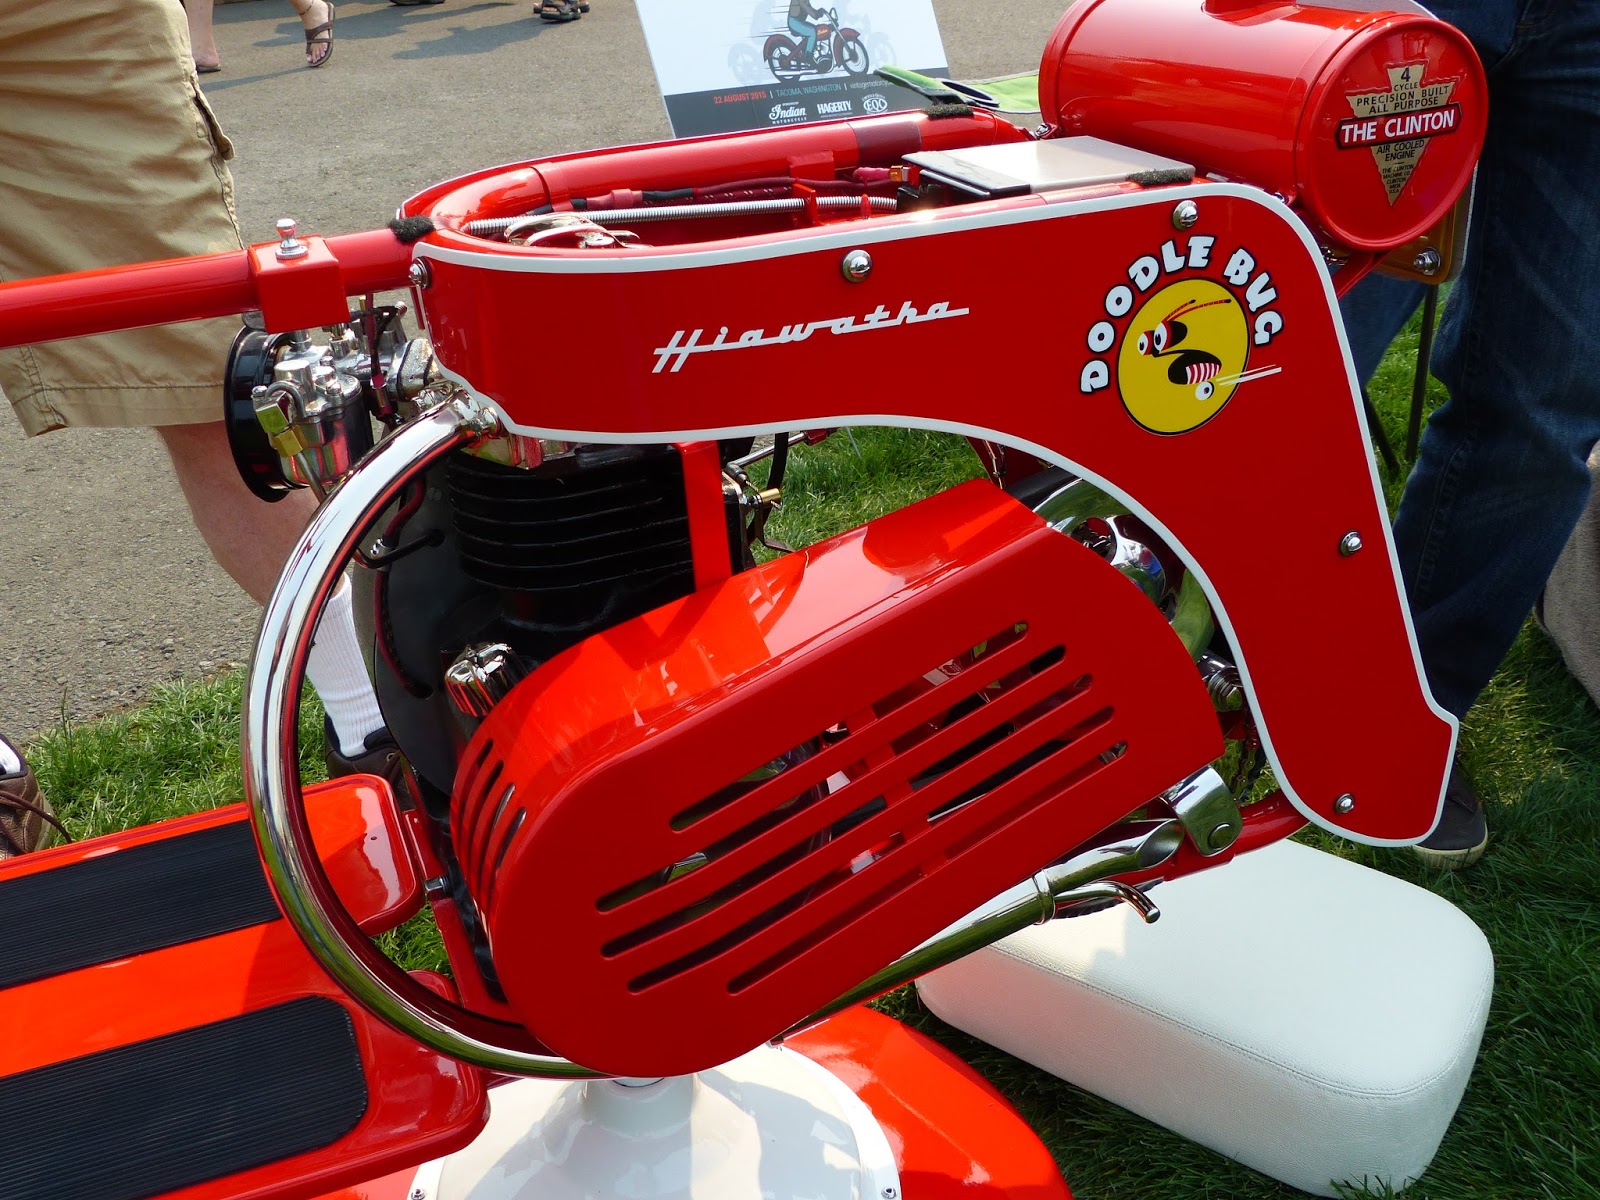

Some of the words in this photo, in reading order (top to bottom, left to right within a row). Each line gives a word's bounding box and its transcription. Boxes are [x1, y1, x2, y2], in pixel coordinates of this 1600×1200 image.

[1400, 67, 1411, 82] 4
[714, 96, 722, 104] 22
[724, 92, 750, 102] AUGUST
[750, 90, 767, 100] 2015
[803, 82, 841, 94] WASHINGTON
[1356, 91, 1415, 107] PRECISION
[1421, 85, 1450, 98] BUILT
[1393, 82, 1418, 92] CYCLE
[768, 103, 807, 120] Indian
[816, 100, 852, 115] HAGERTY
[1368, 106, 1389, 115] ALL
[1394, 96, 1439, 111] PURPOSE
[1341, 121, 1377, 143] THE
[1384, 109, 1455, 138] CLINTON
[1376, 144, 1391, 155] AIR
[1393, 139, 1425, 152] COOLED
[1384, 150, 1416, 162] ENGINE
[1080, 235, 1216, 393] DOODLE
[1223, 248, 1283, 346] BUG
[651, 300, 970, 374] Hiawatha
